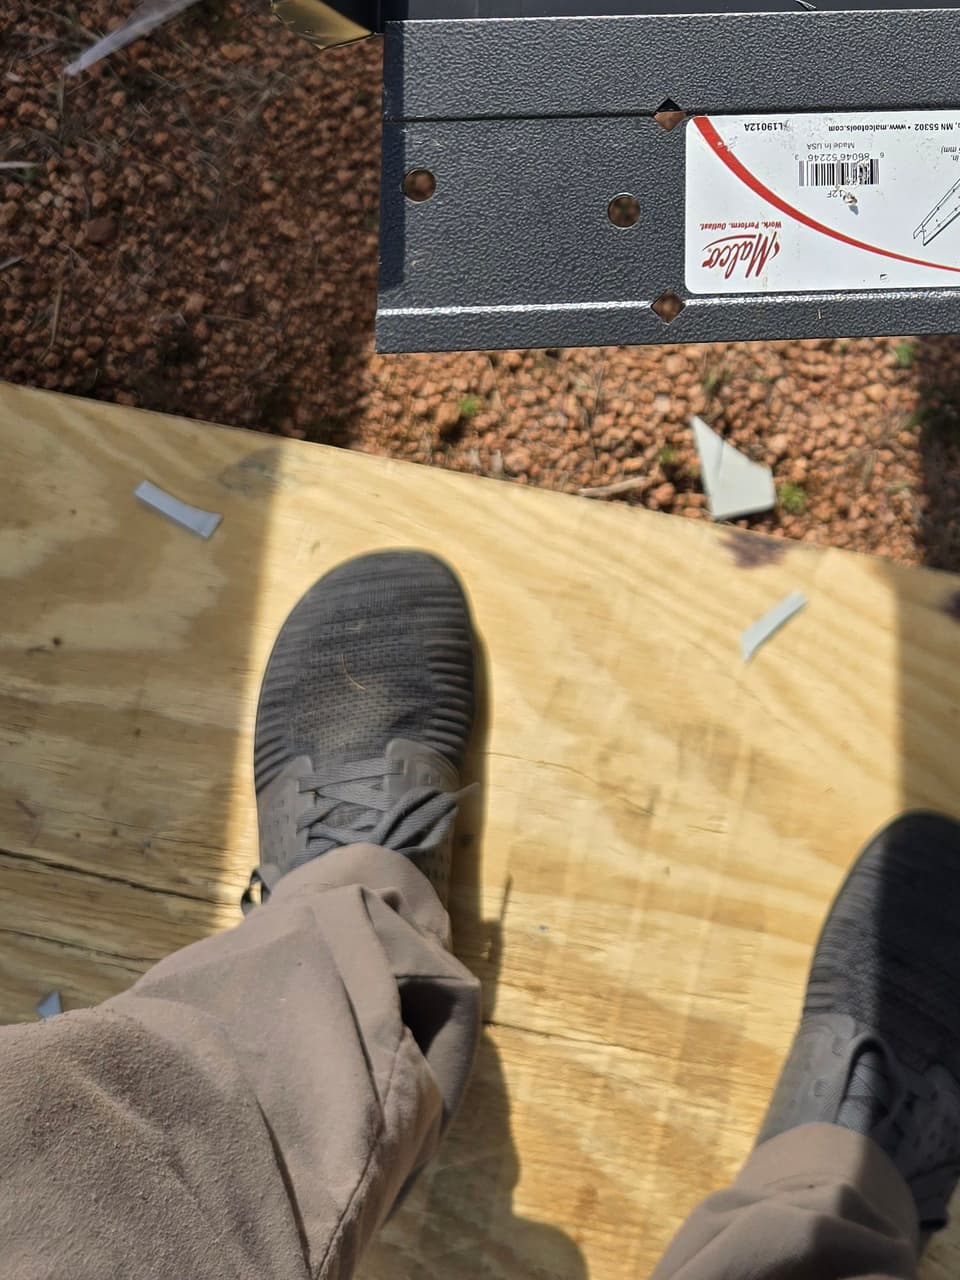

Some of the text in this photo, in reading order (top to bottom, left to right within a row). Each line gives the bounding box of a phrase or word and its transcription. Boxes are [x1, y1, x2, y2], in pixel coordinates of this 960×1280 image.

[744, 122, 783, 131] L19012A
[828, 124, 906, 132] www.malcotools.com
[914, 123, 939, 131] 55302
[941, 122, 953, 130] MN
[940, 146, 957, 154] mm)
[807, 154, 837, 162] 52246
[840, 152, 870, 160] 86046
[728, 222, 759, 230] Perform.
[702, 232, 780, 279] Malco
